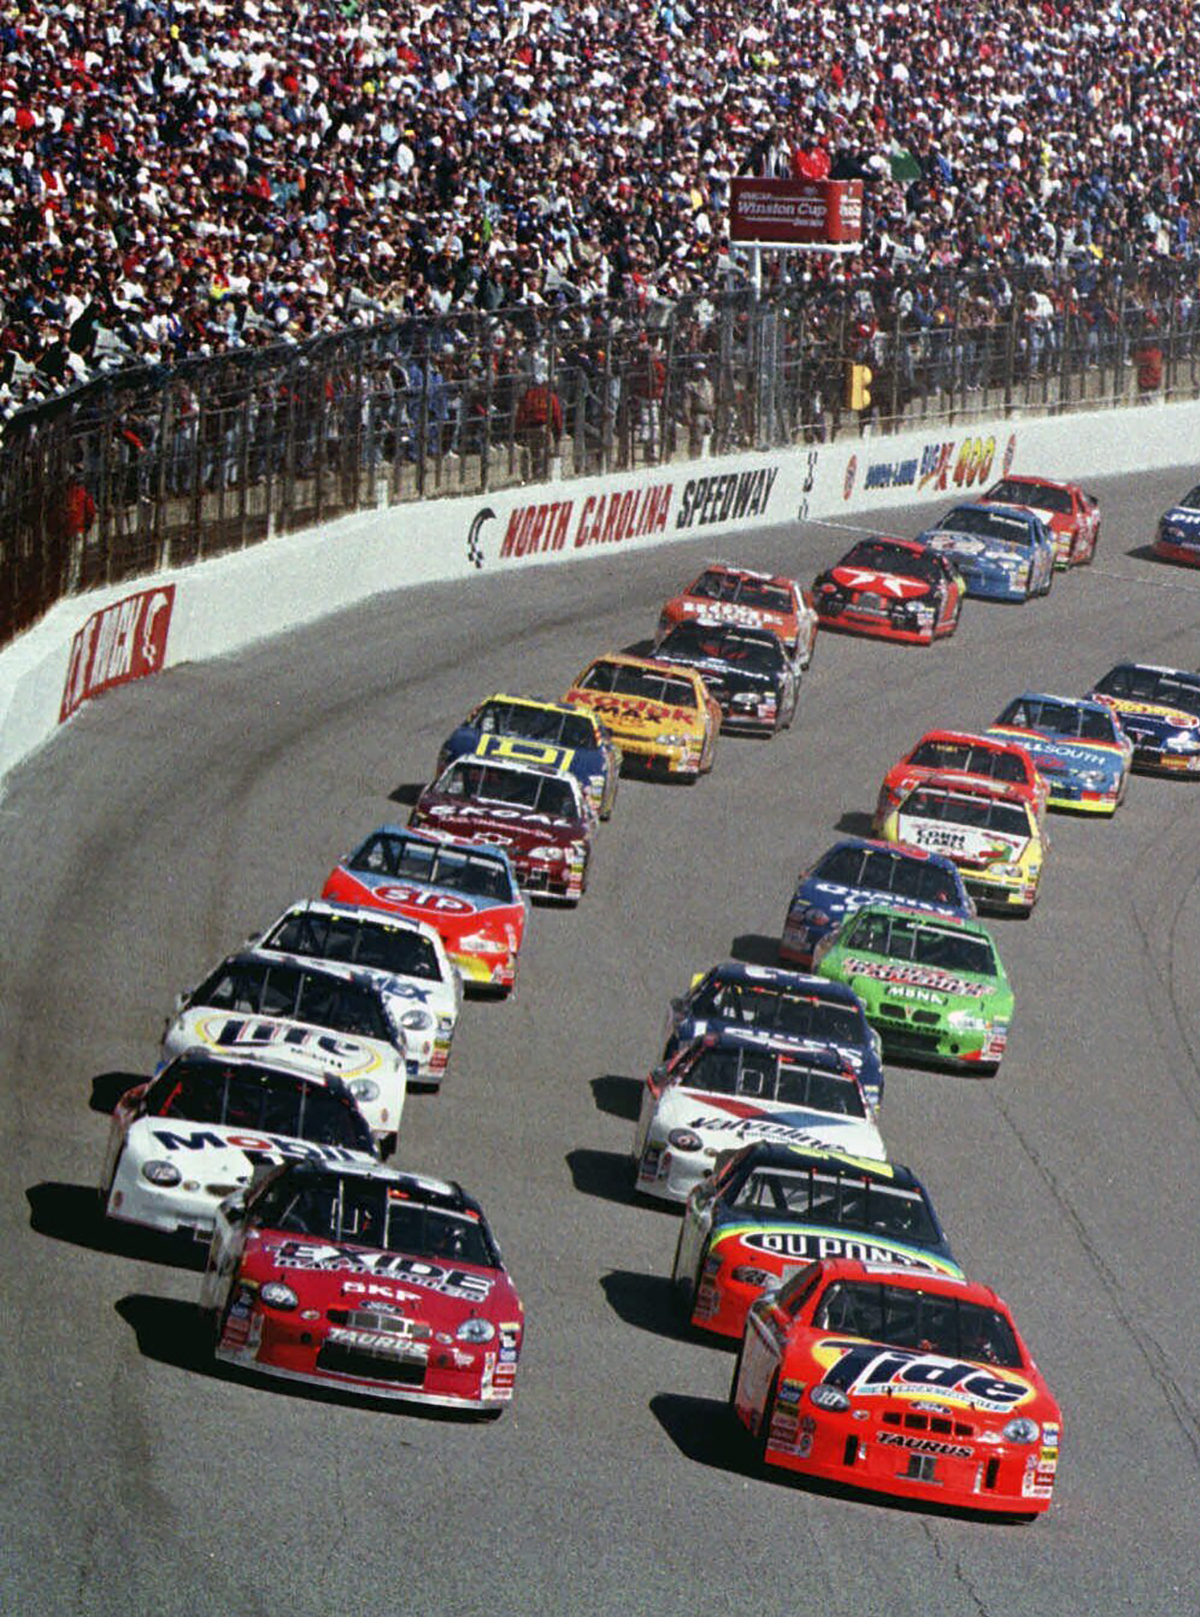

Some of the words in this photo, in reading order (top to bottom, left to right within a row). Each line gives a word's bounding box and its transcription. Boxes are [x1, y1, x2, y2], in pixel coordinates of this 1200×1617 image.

[738, 201, 795, 215] Winston
[798, 202, 828, 217] Cup
[500, 500, 572, 559] NORTH
[574, 482, 674, 548] CAROLINA
[675, 466, 780, 530] SPEEDWAY
[1024, 740, 1106, 765] LLSOUTH
[916, 828, 966, 845] CORN
[383, 885, 463, 911] STP
[889, 986, 943, 1005] MBNA
[274, 1240, 496, 1297] EXIDE
[819, 1338, 1031, 1403] Tide
[877, 1431, 975, 1458] TAURUS
